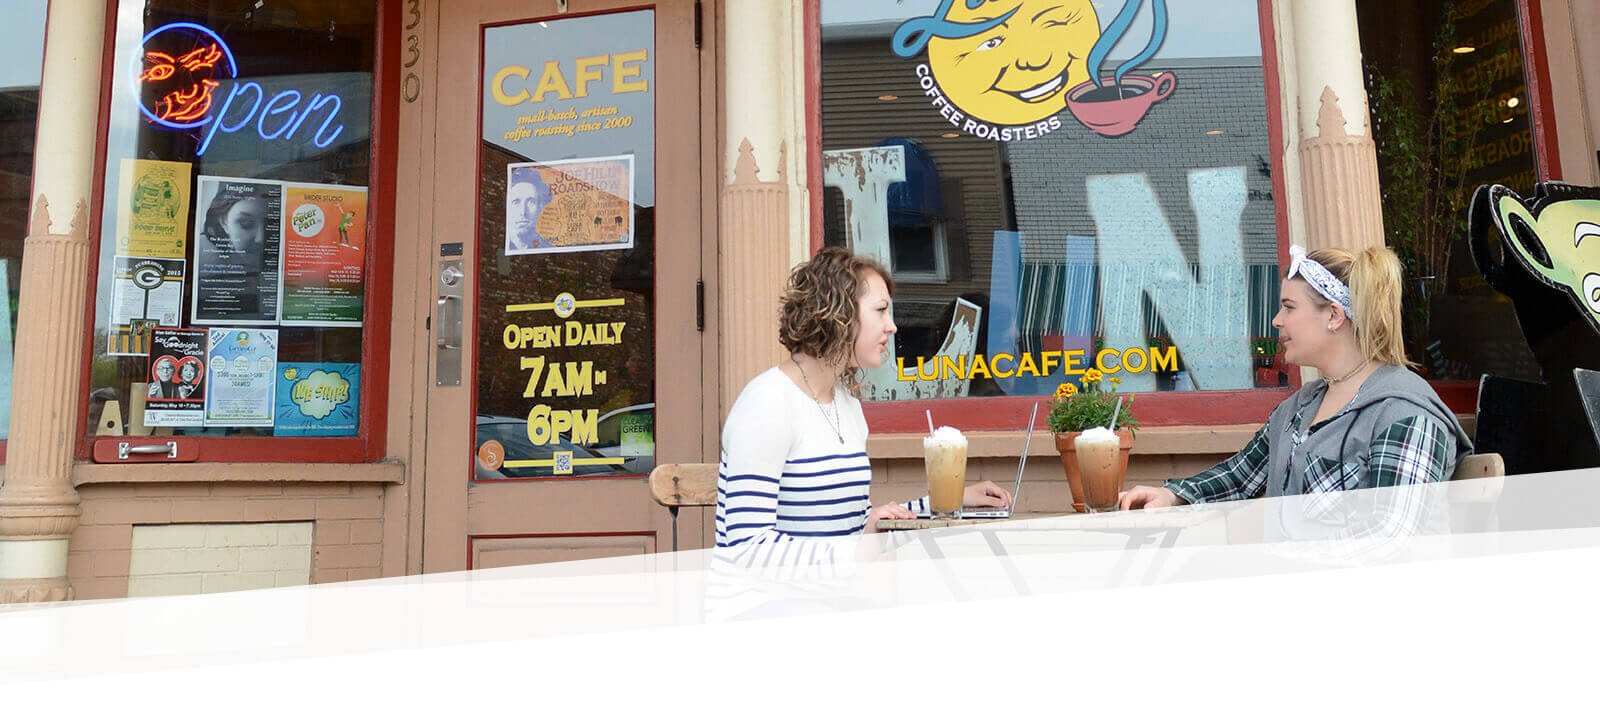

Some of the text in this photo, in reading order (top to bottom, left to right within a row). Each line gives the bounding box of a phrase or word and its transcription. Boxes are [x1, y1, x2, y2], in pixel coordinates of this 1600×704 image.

[403, 0, 421, 103] 330
[128, 21, 344, 157] Open
[491, 48, 649, 106] CAFE
[517, 105, 618, 125] small-batch, artisan
[916, 63, 1062, 142] COFFEE ROASTERS
[504, 116, 633, 142] coffee roasting since 2000
[226, 184, 254, 193] Imagine
[293, 209, 317, 226] Peter
[297, 217, 316, 232] Pan
[154, 336, 167, 345] Say
[163, 340, 199, 351] Goodnight
[503, 320, 626, 349] OPEN DAILY
[520, 355, 593, 398] 7AM
[896, 346, 1179, 382] LUNACAFECOM
[296, 383, 349, 402] WE SHIP!
[527, 404, 600, 446] 6PM
[623, 425, 650, 433] GREEN
